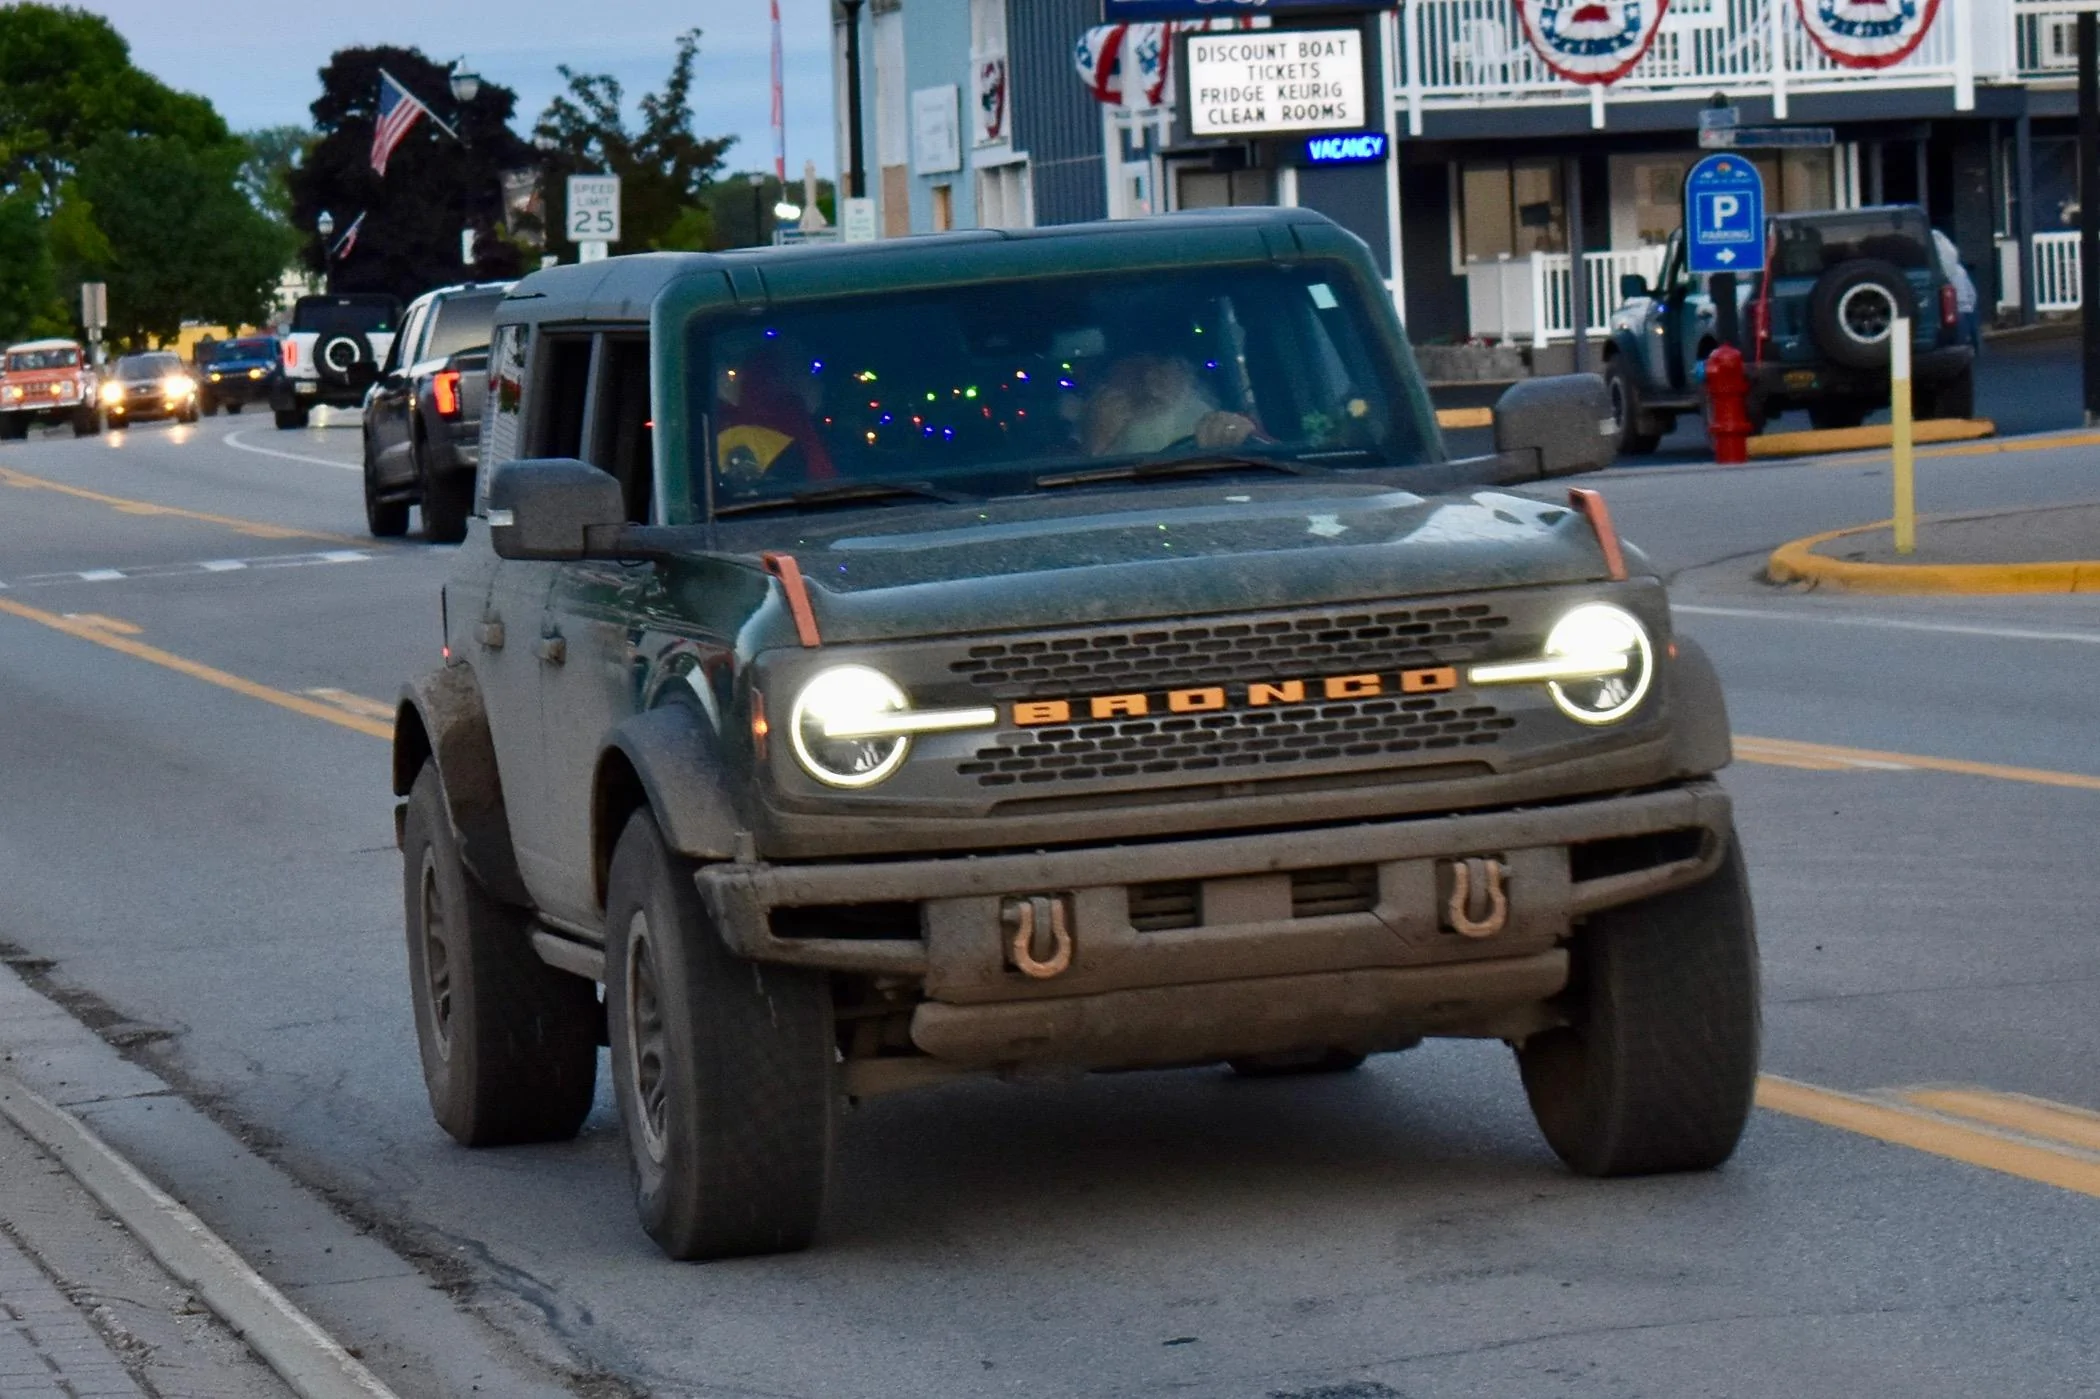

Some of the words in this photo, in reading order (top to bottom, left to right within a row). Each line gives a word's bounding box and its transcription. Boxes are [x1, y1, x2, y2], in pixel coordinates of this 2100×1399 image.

[1197, 43, 1288, 62] DISCOUNT
[1298, 40, 1347, 58] BOAT
[1247, 62, 1321, 81] TICKETS
[1200, 85, 1265, 104] FRIDGE
[1278, 81, 1343, 100] KEURIG
[1208, 107, 1266, 125] CLEAN
[1282, 103, 1347, 121] ROOMS
[1308, 136, 1384, 160] VACANCY
[574, 184, 615, 194] SPEED
[577, 197, 610, 207] LIMIT
[1713, 196, 1739, 229] P
[575, 210, 614, 232] 25
[1701, 230, 1750, 239] PARKING
[1013, 667, 1457, 726] BRONCO
